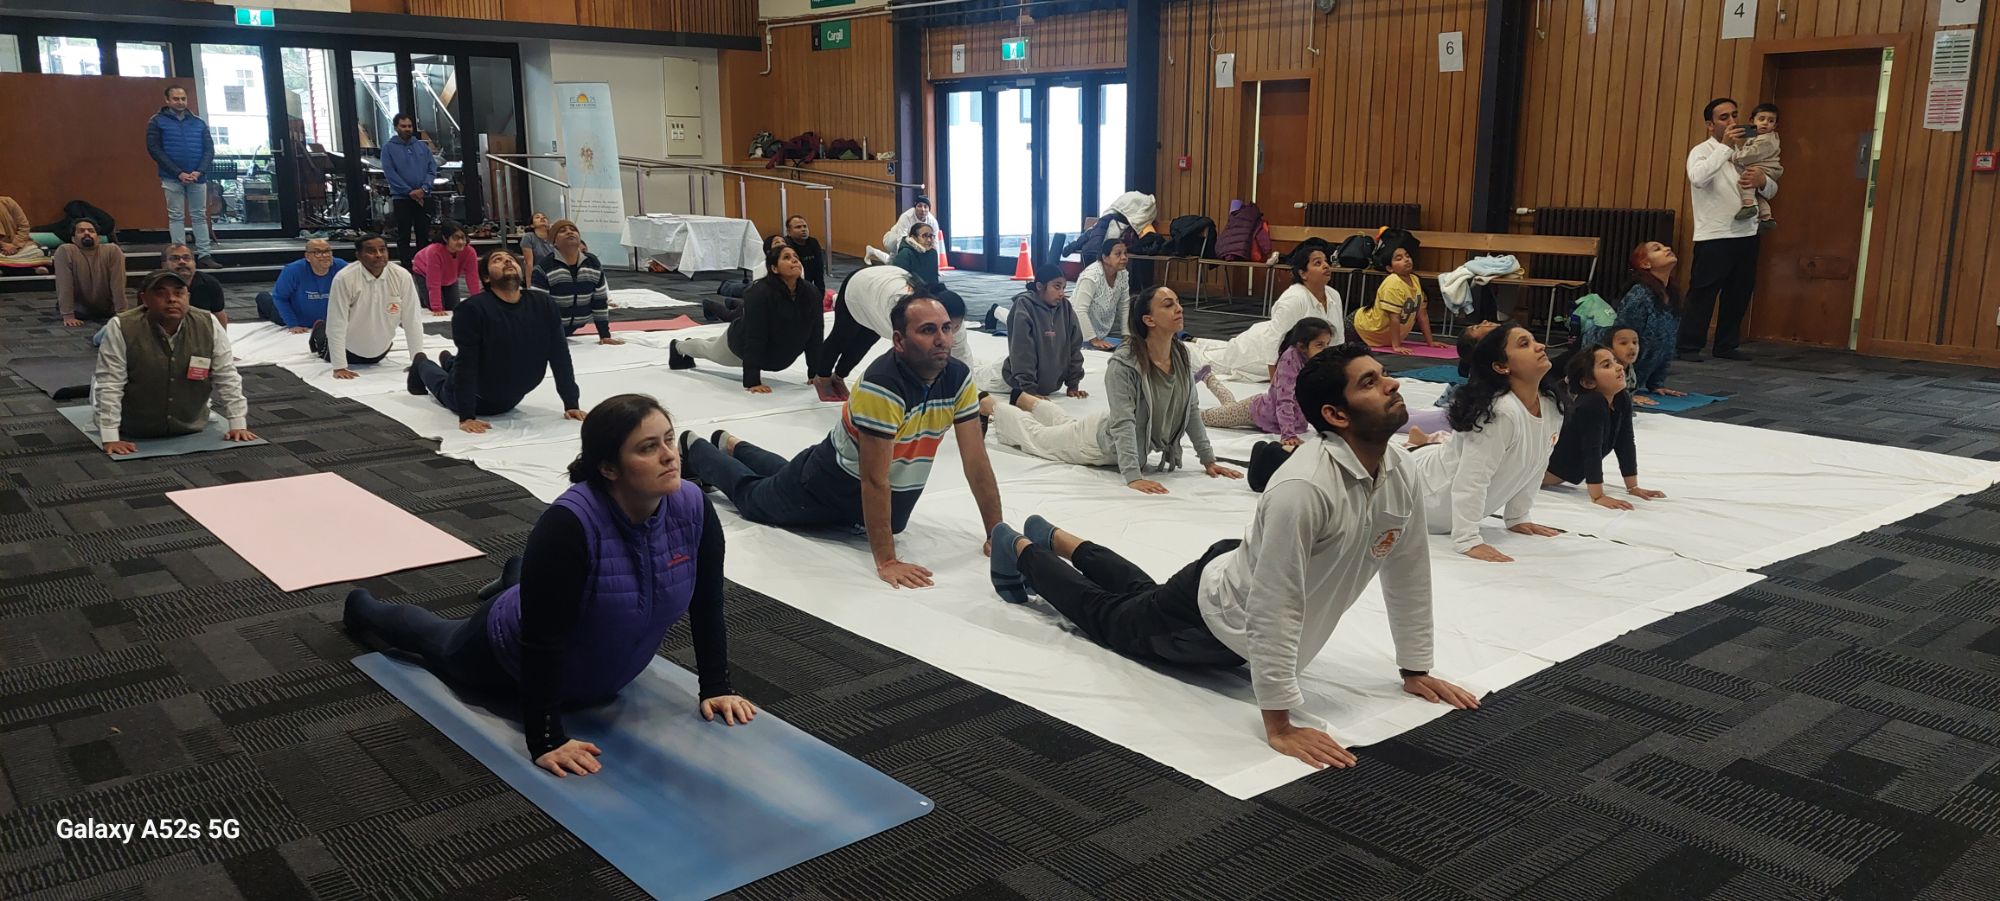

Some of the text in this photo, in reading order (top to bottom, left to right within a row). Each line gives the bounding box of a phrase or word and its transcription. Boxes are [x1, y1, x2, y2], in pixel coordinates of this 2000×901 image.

[1734, 2, 1745, 18] 4
[827, 28, 844, 43] Cargill
[1446, 41, 1454, 55] 6
[1221, 61, 1227, 73] 7
